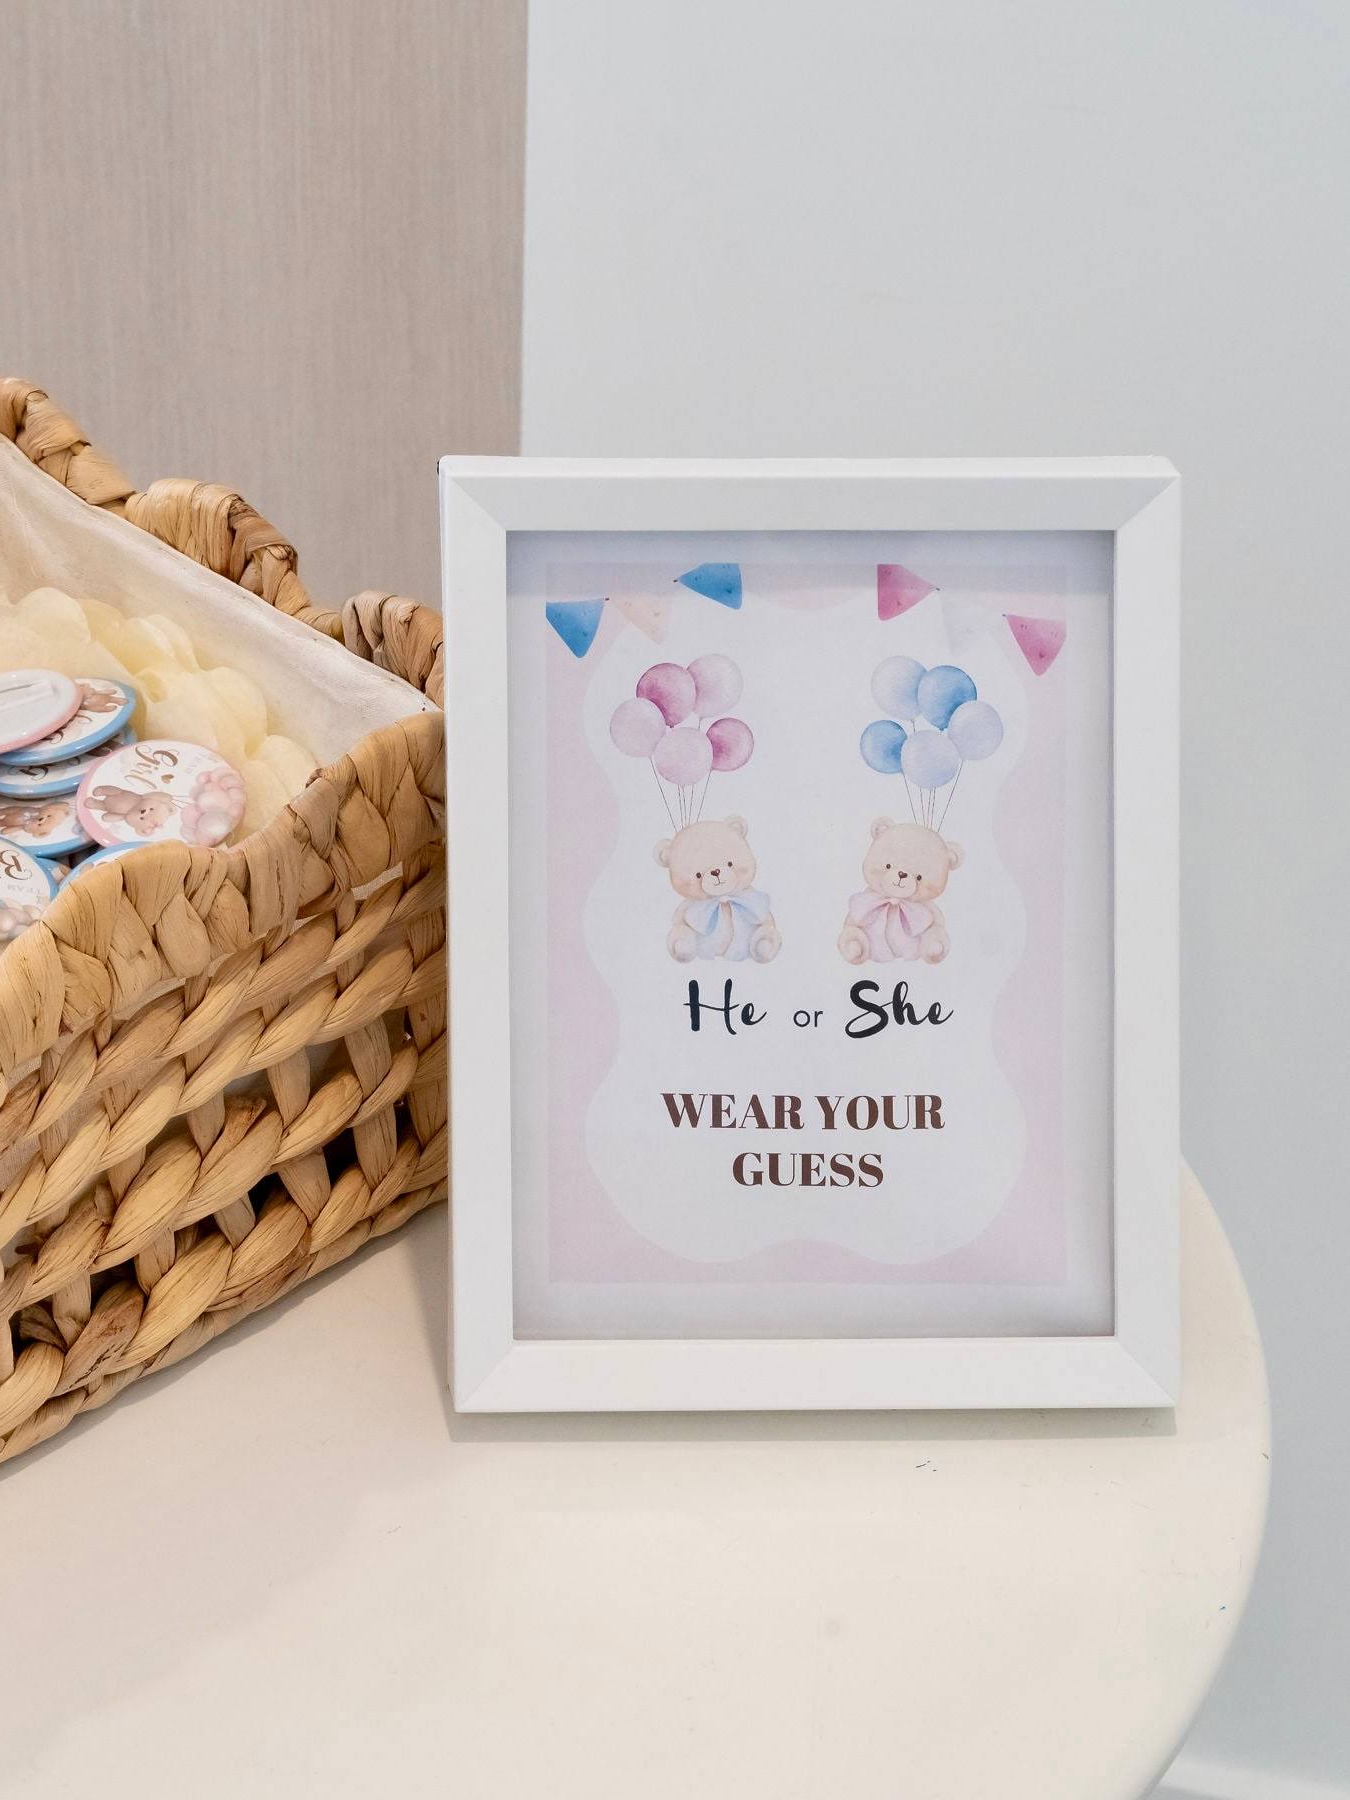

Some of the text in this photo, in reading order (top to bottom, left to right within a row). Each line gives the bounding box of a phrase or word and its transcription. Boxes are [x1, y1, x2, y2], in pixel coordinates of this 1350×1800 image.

[123, 745, 179, 790] Girl
[683, 978, 954, 1038] He or She
[660, 1092, 946, 1131] WEAR YOUR
[732, 1152, 884, 1188] GUESS
